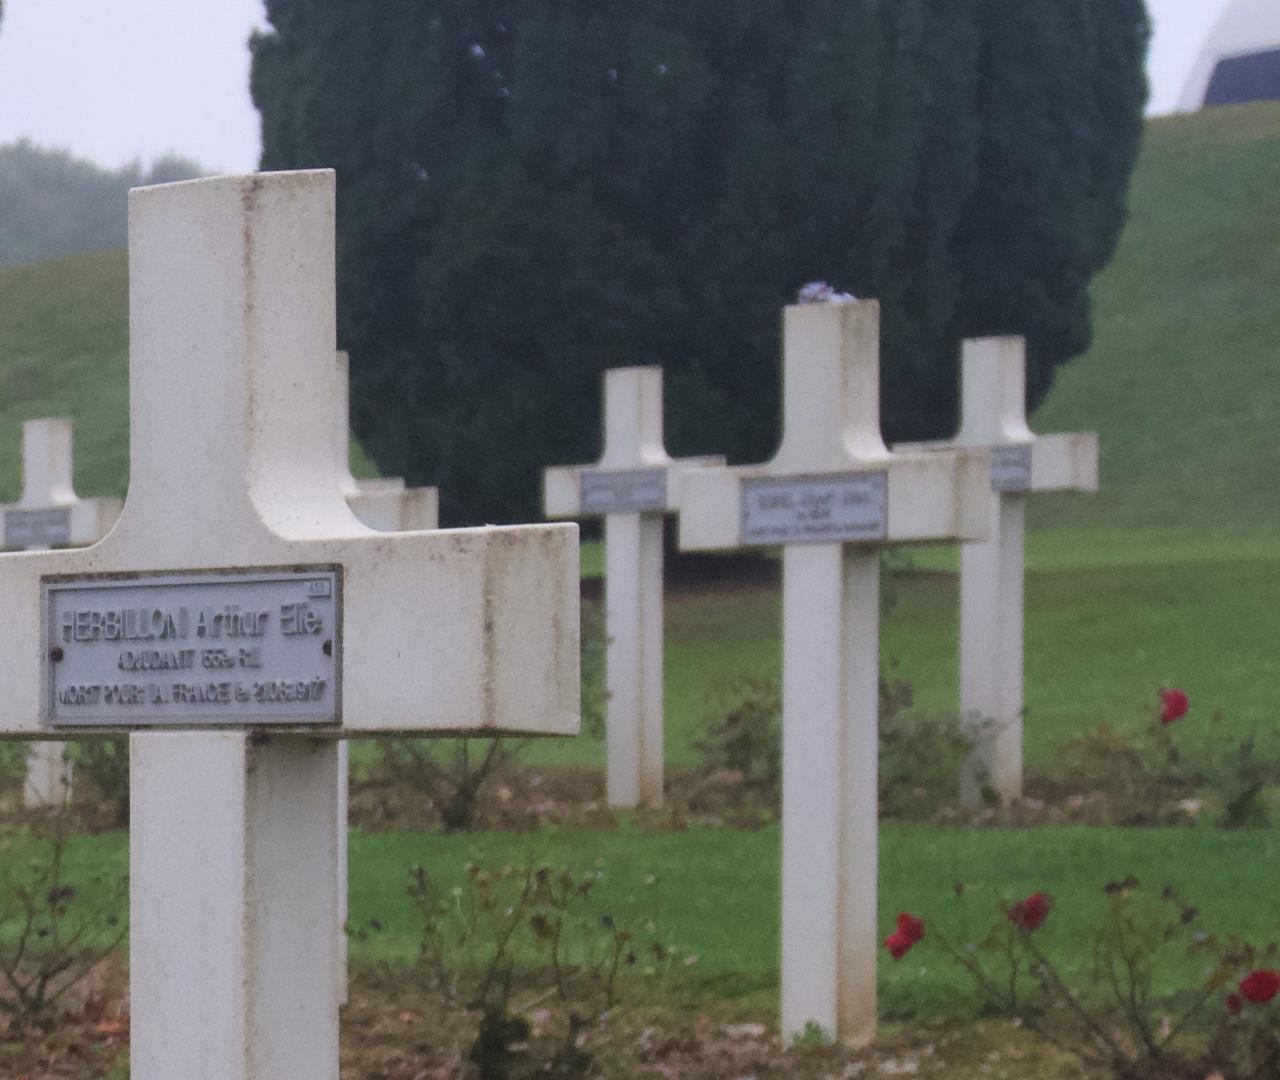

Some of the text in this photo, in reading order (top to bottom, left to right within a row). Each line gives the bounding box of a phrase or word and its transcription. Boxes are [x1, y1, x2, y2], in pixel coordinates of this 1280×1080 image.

[60, 606, 188, 640] HERBILLON
[195, 603, 269, 637] Arthur
[117, 649, 195, 672] ADJUDANT
[59, 685, 100, 705] MORT
[104, 684, 144, 704] POUR
[146, 683, 169, 704] LA
[171, 682, 232, 704] FRANCE
